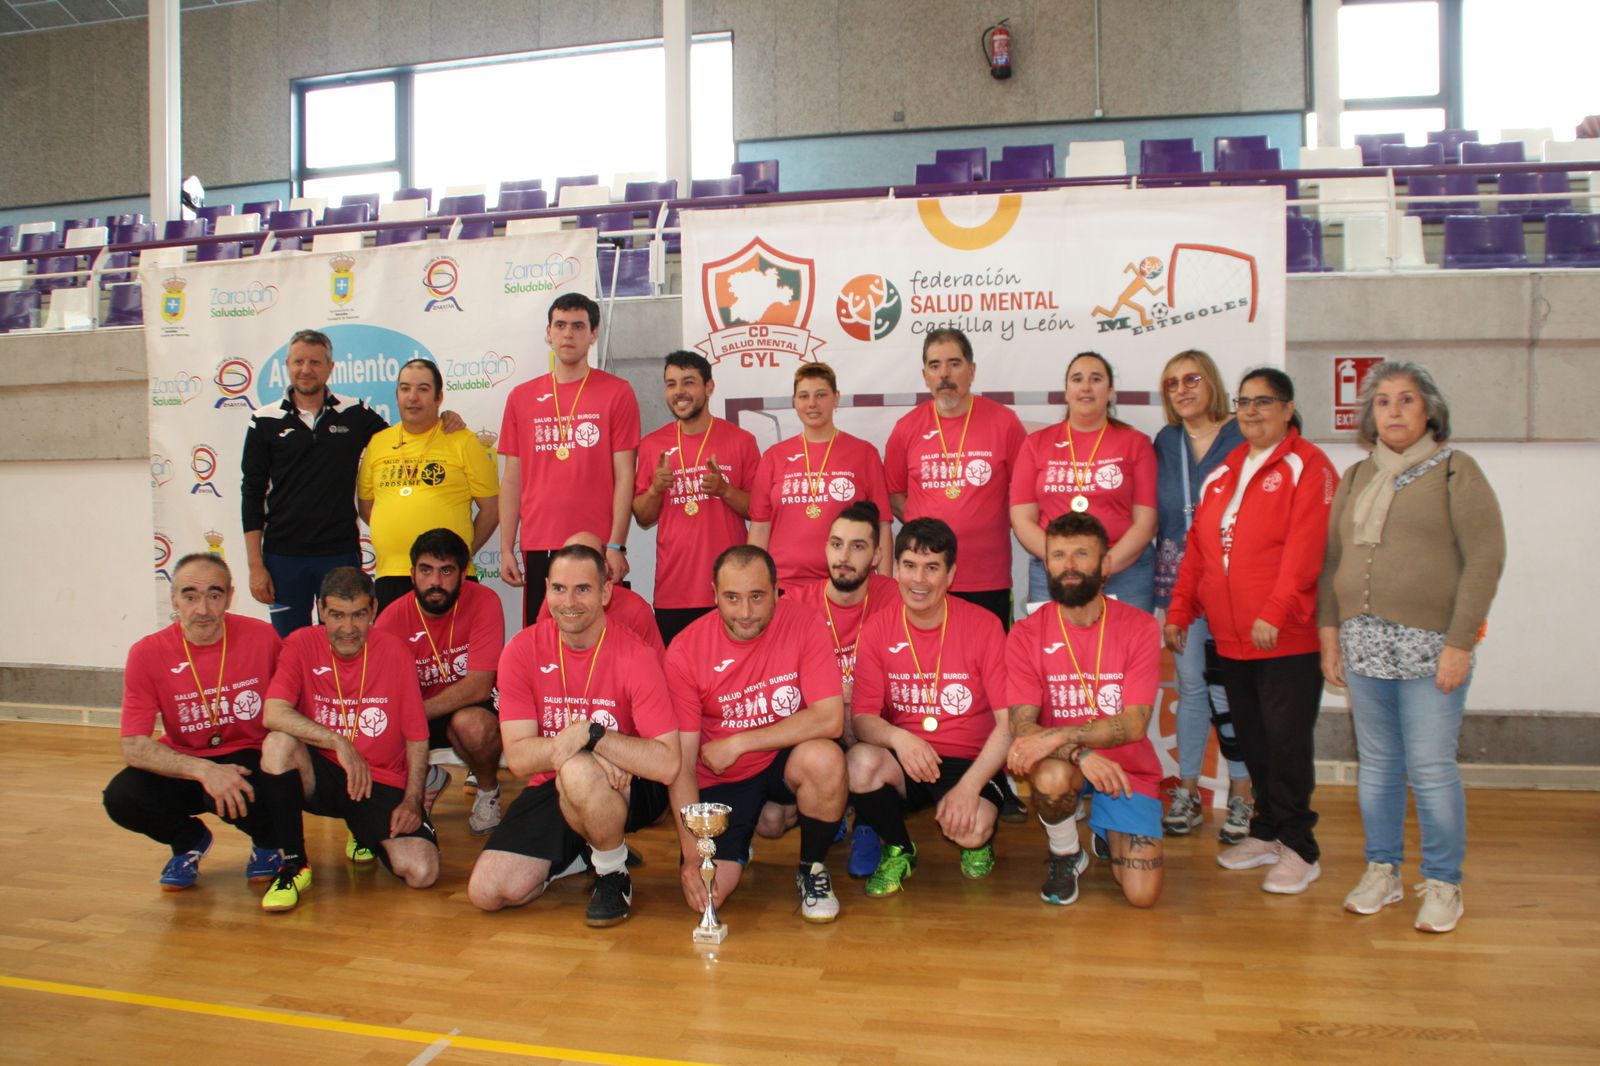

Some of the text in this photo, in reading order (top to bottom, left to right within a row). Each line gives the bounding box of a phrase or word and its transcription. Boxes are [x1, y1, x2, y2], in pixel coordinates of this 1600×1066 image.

[504, 257, 574, 281] Zaratán
[503, 280, 553, 294] Saludable
[909, 266, 1022, 295] federación
[210, 283, 273, 306] Zaratán
[911, 290, 1060, 315] SALUD MENTAL
[210, 306, 256, 319] Saludable
[748, 326, 770, 338] CD
[1000, 320, 1015, 342] y
[1023, 313, 1075, 333] León
[721, 338, 799, 354] SALUD MENTAL
[446, 355, 509, 378] Zaratán
[740, 352, 780, 368] CYL
[446, 378, 491, 392] Saludable
[535, 441, 576, 452] PROSAME
[379, 480, 421, 489] PROSAME
[922, 480, 967, 490] PROSAME
[1044, 484, 1096, 493] PROSAME
[781, 494, 829, 505] PROSAME
[888, 672, 910, 680] SALUD
[174, 692, 198, 701] SALUD
[232, 678, 259, 690] BURGOS
[718, 692, 742, 703] SALUD
[769, 672, 798, 685] BURGOS
[543, 696, 563, 704] SALUD
[721, 714, 775, 729] PROSAME
